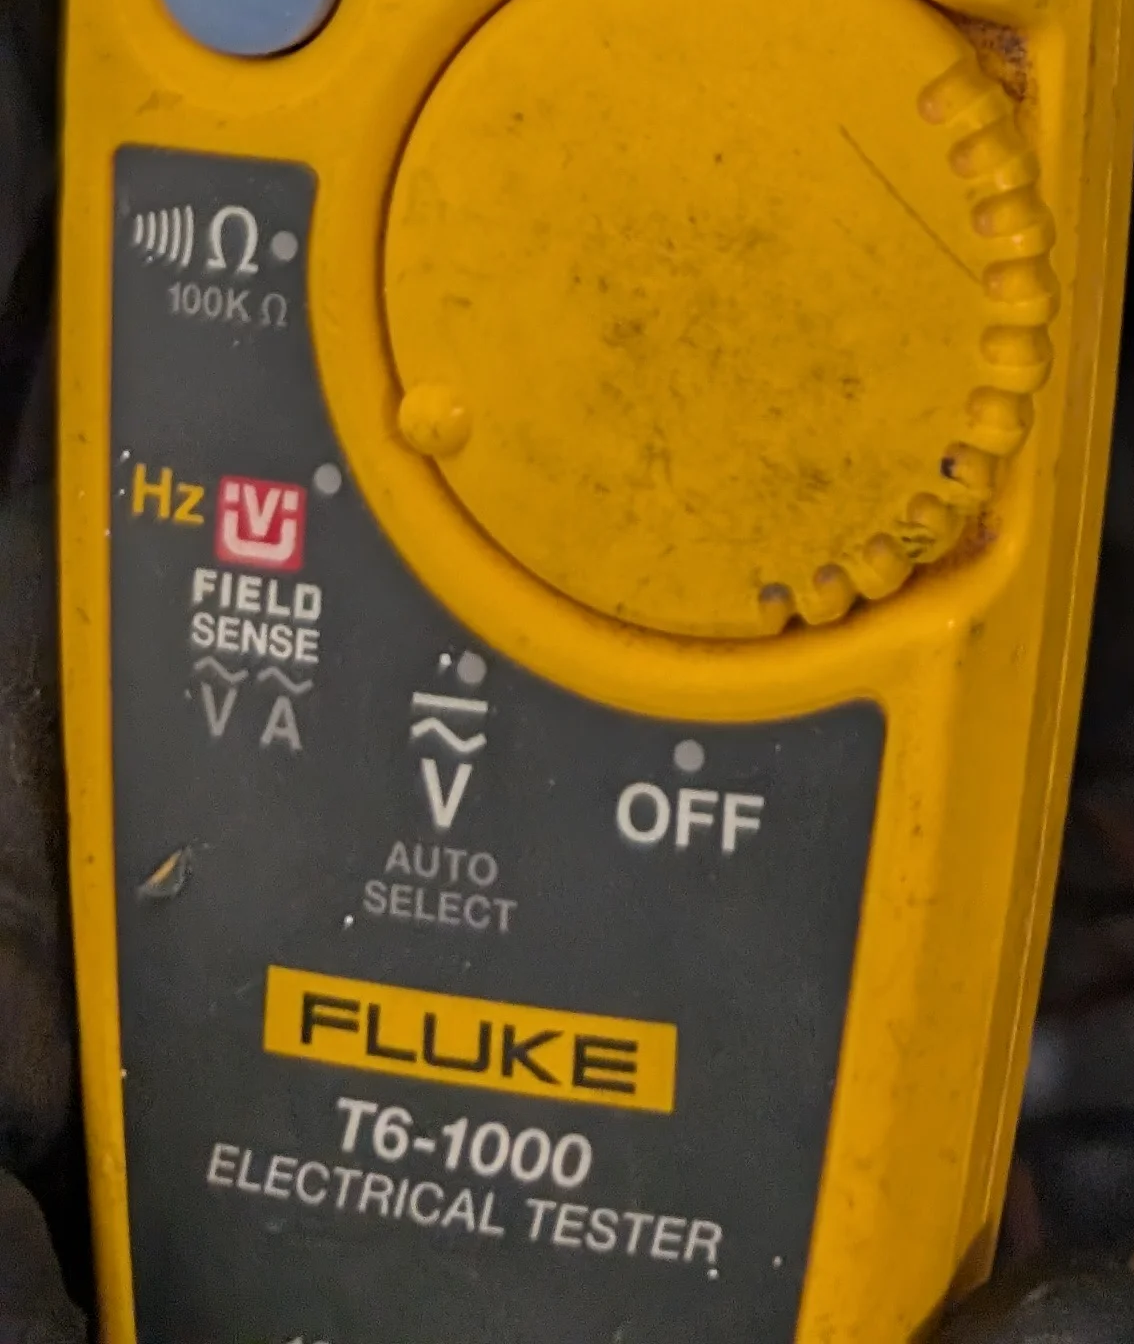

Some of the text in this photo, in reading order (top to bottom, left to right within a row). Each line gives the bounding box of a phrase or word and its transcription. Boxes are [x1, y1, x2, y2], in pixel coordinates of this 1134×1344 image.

[130, 464, 206, 525] Hz
[192, 568, 322, 620] FIELD
[190, 613, 321, 665] SENSE
[201, 685, 303, 751] V A
[420, 758, 473, 831] V
[614, 782, 764, 853] OFF
[383, 840, 498, 887] AUTO
[362, 880, 518, 933] SELECT
[299, 991, 639, 1096] FLUKE
[336, 1098, 594, 1188] T6-1000
[206, 1143, 723, 1264] ELECTRICAL TESTER
